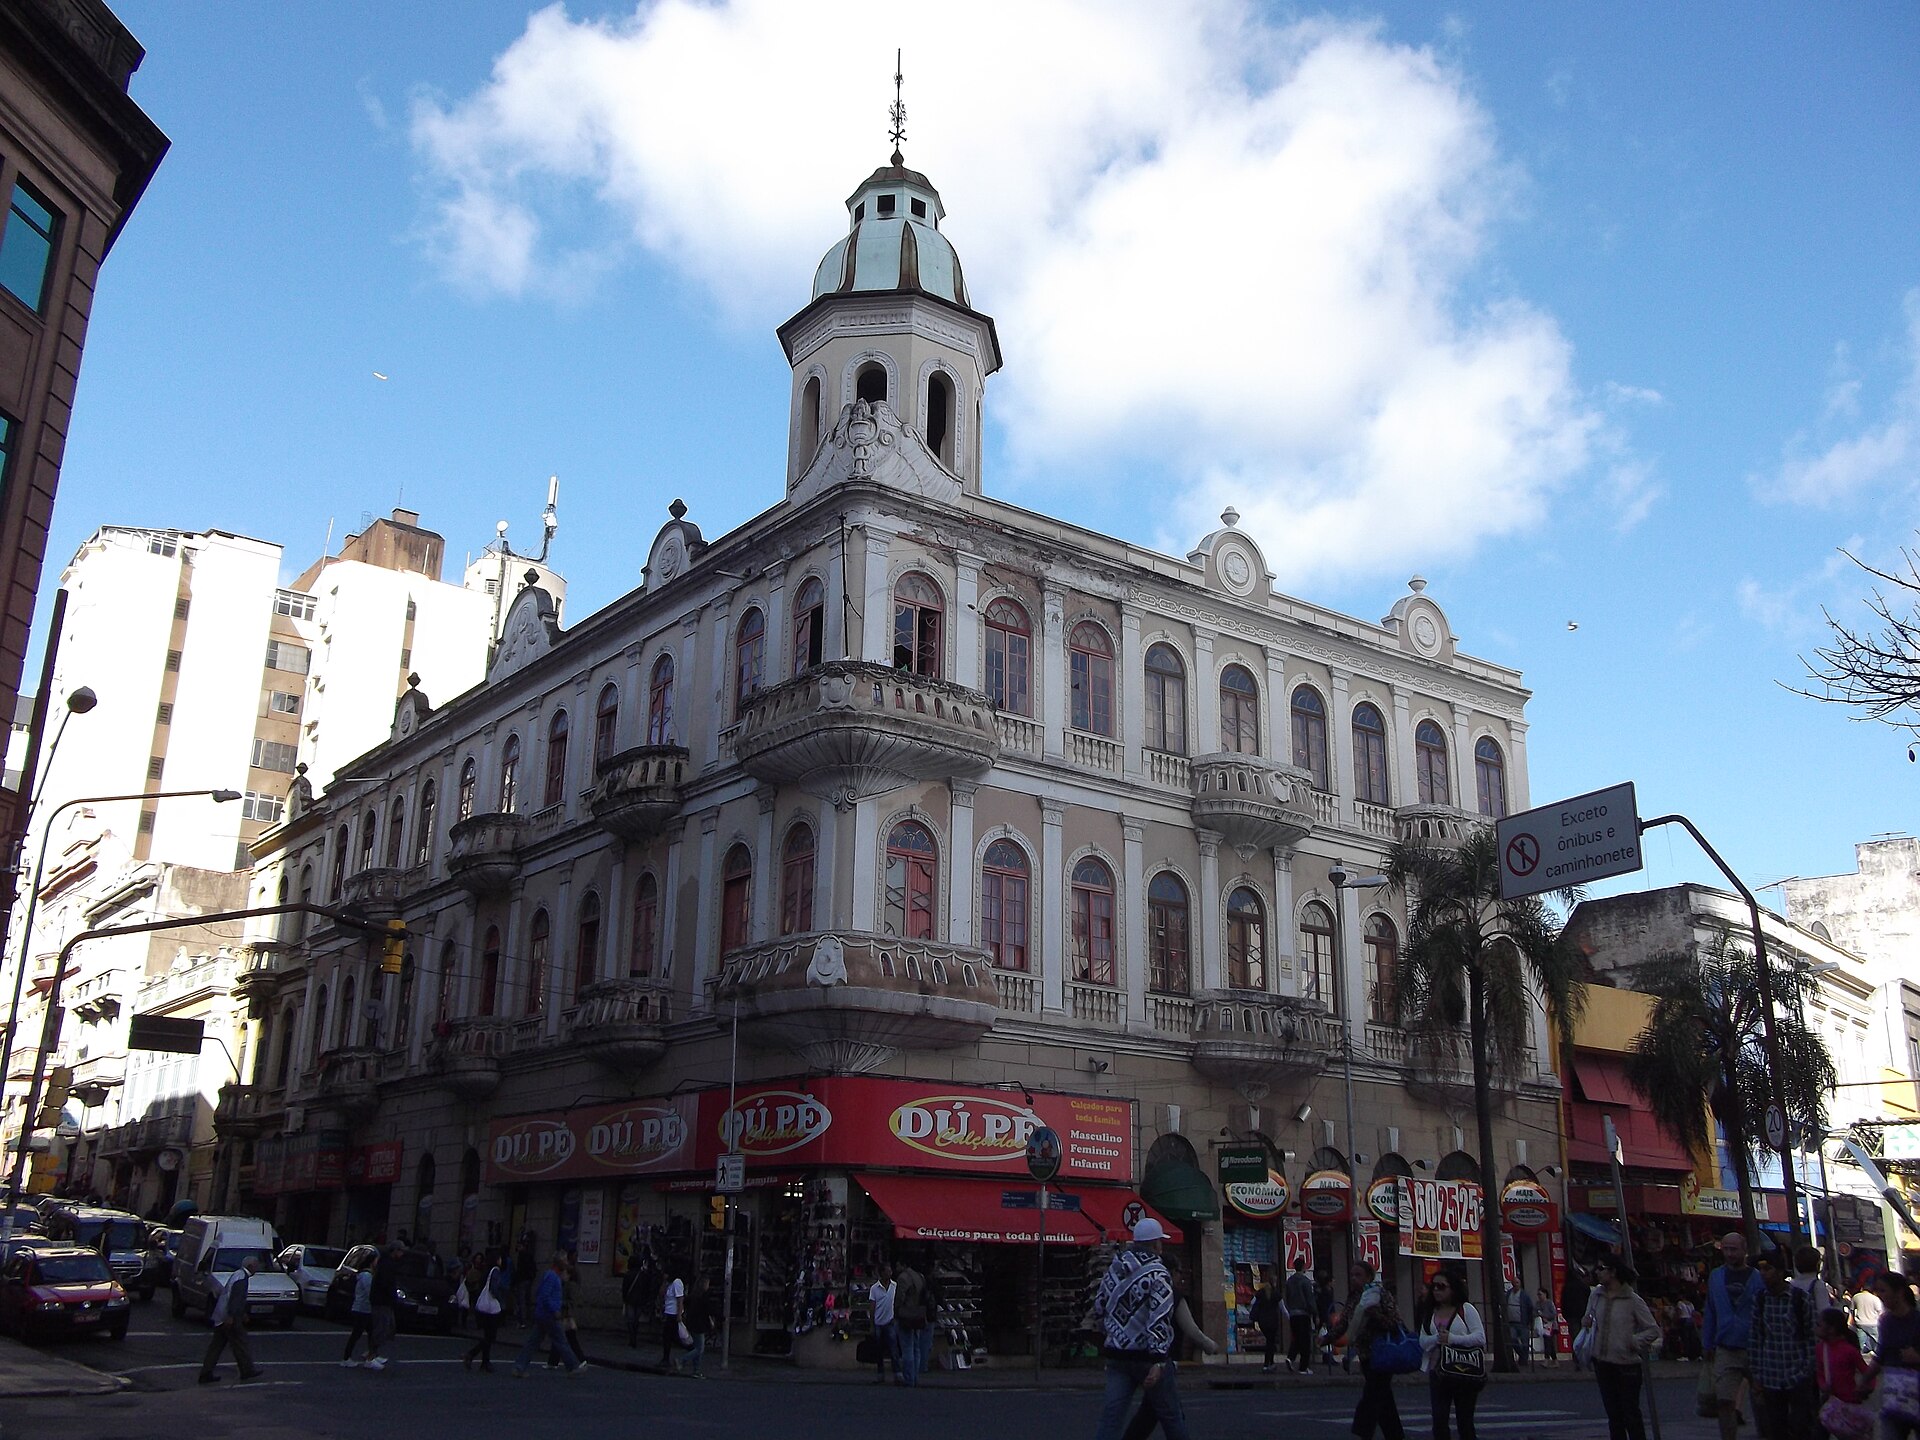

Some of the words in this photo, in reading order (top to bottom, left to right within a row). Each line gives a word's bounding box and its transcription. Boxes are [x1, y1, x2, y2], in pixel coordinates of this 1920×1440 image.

[1561, 805, 1608, 827] Exceto
[1558, 830, 1602, 851] ônibus
[1607, 827, 1616, 838] e
[1546, 846, 1635, 878] caminhonete
[1071, 1100, 1103, 1111] Calçados
[1105, 1105, 1122, 1113] para
[1075, 1114, 1092, 1122] toda
[897, 1101, 971, 1141] DÚ
[1767, 1109, 1782, 1133] 20
[935, 1127, 1027, 1150] Calçados
[1070, 1129, 1123, 1143] Masculino
[1070, 1143, 1119, 1157] Feminino
[1070, 1157, 1111, 1171] Infantil
[1320, 1180, 1341, 1189] MAIS
[1516, 1189, 1534, 1197] MAIS
[1414, 1181, 1438, 1230] 60
[1438, 1185, 1459, 1232] 25
[1460, 1186, 1480, 1232] 25
[917, 1227, 971, 1240] Calçados
[973, 1231, 1000, 1241] para
[1005, 1232, 1032, 1241] toda
[1285, 1231, 1312, 1270] 25
[1444, 1345, 1481, 1369] EVERLAST
